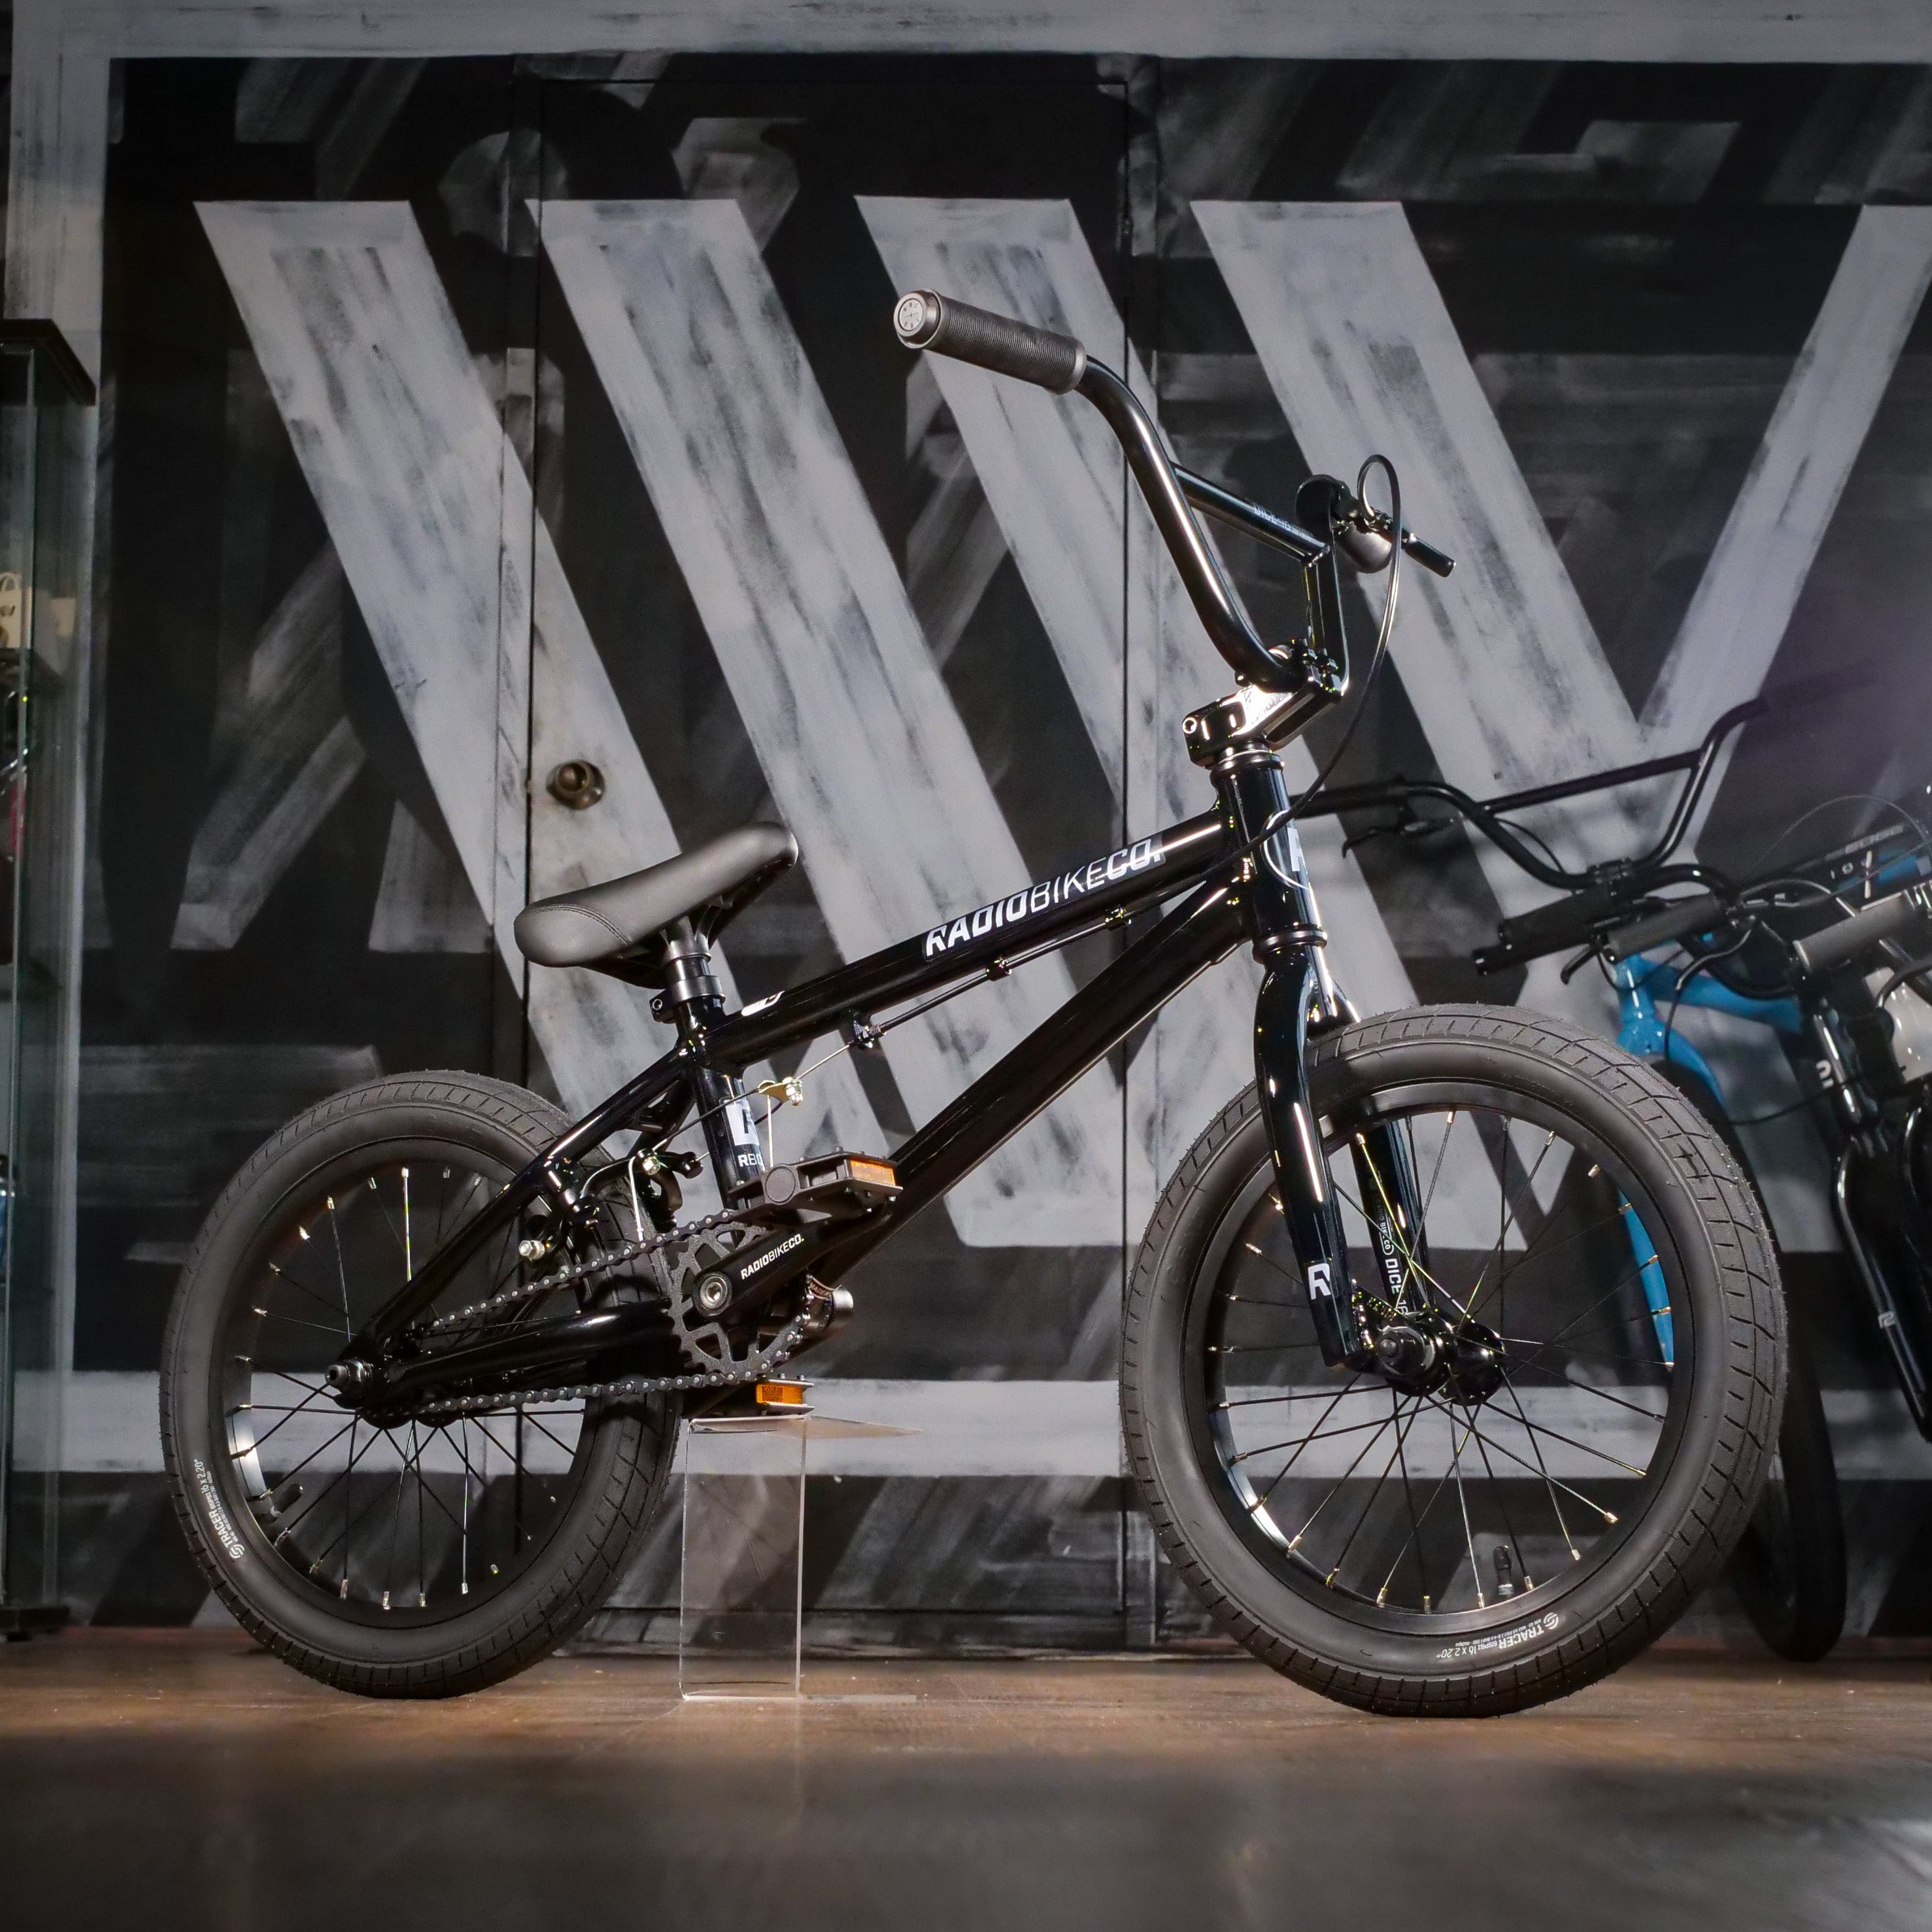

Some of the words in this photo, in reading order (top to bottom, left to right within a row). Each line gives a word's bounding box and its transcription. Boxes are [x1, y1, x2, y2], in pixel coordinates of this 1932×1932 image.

[741, 1234, 804, 1280] RADIOBIKECO.
[1308, 1263, 1331, 1300] R
[1385, 1259, 1402, 1294] DICE
[209, 1509, 233, 1548] TRACER
[1499, 1625, 1544, 1650] TRACER
